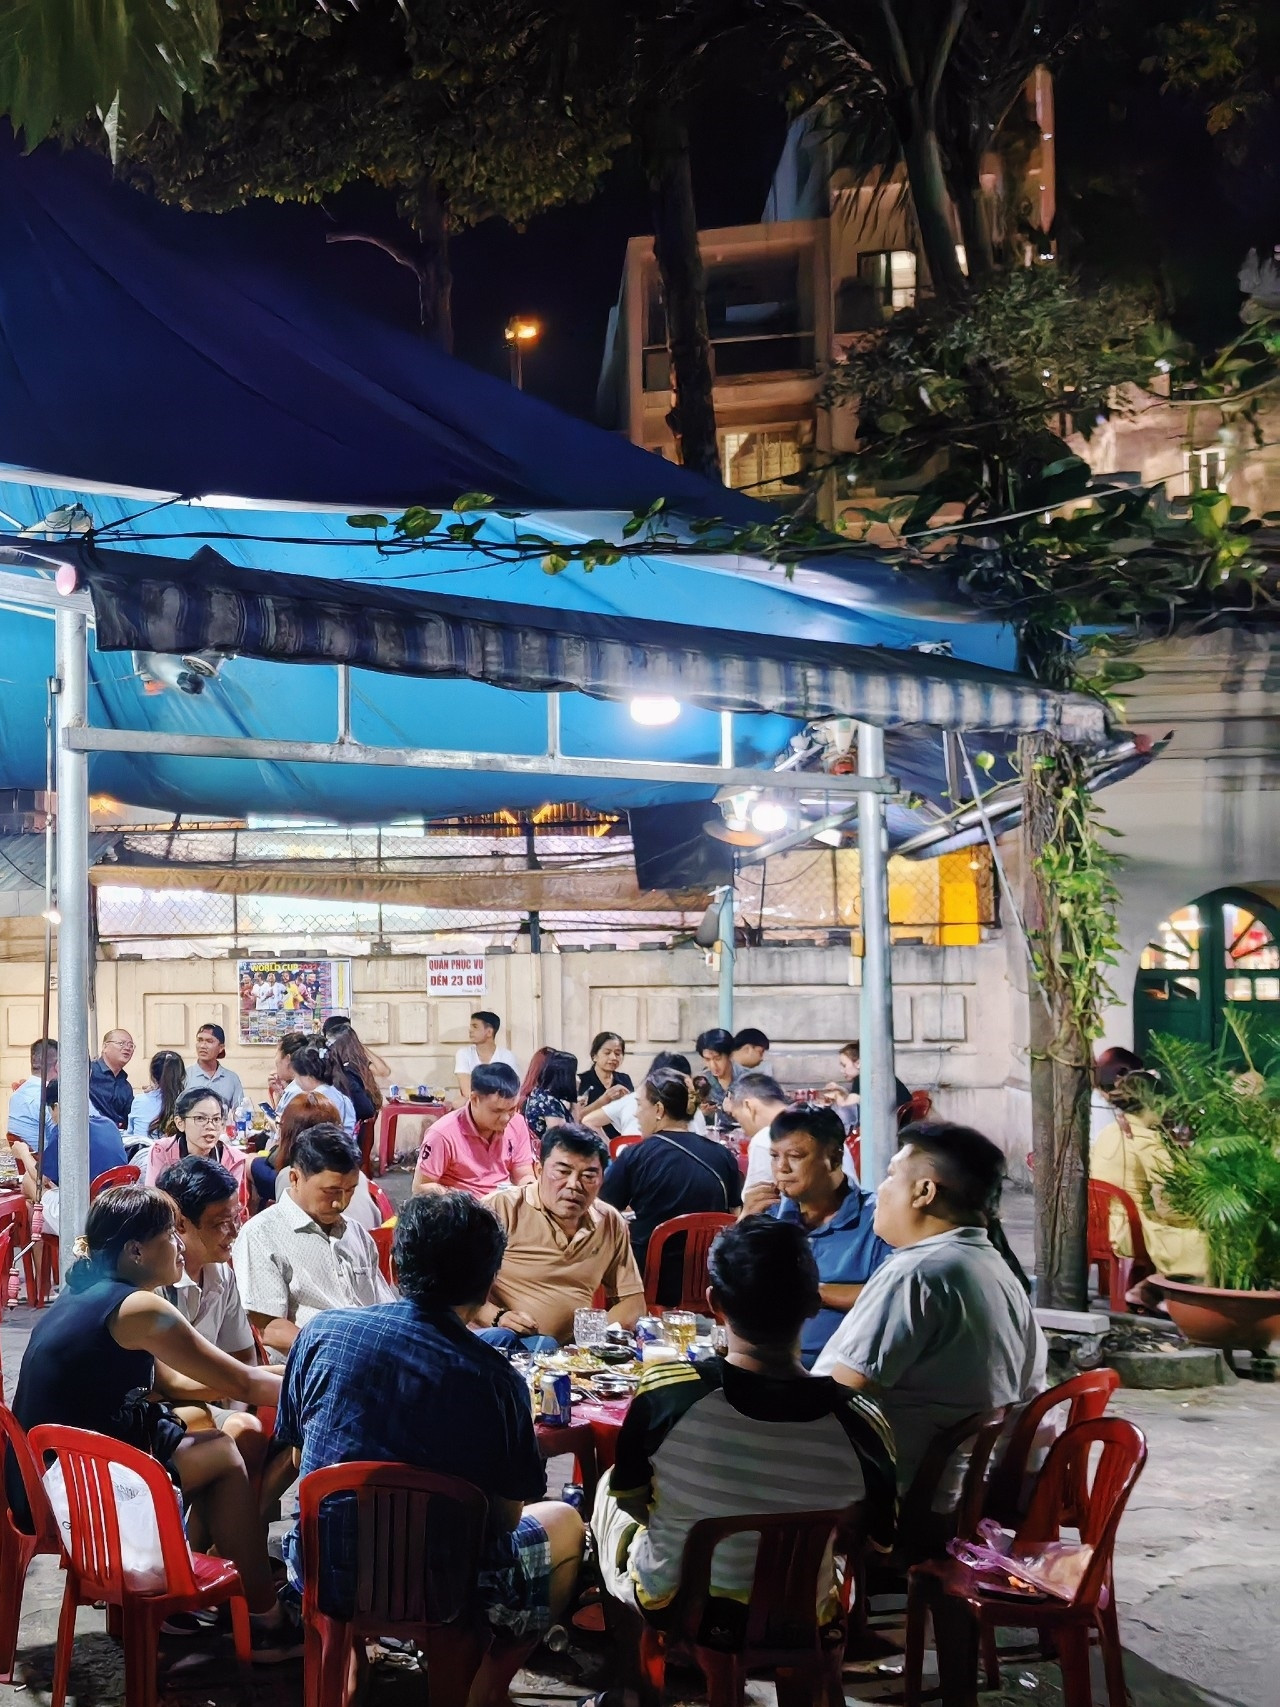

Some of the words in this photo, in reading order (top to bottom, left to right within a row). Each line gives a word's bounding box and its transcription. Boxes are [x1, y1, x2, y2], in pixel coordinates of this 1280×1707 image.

[250, 963, 281, 972] WORLD
[282, 963, 298, 971] CUP
[451, 975, 463, 986] 23
